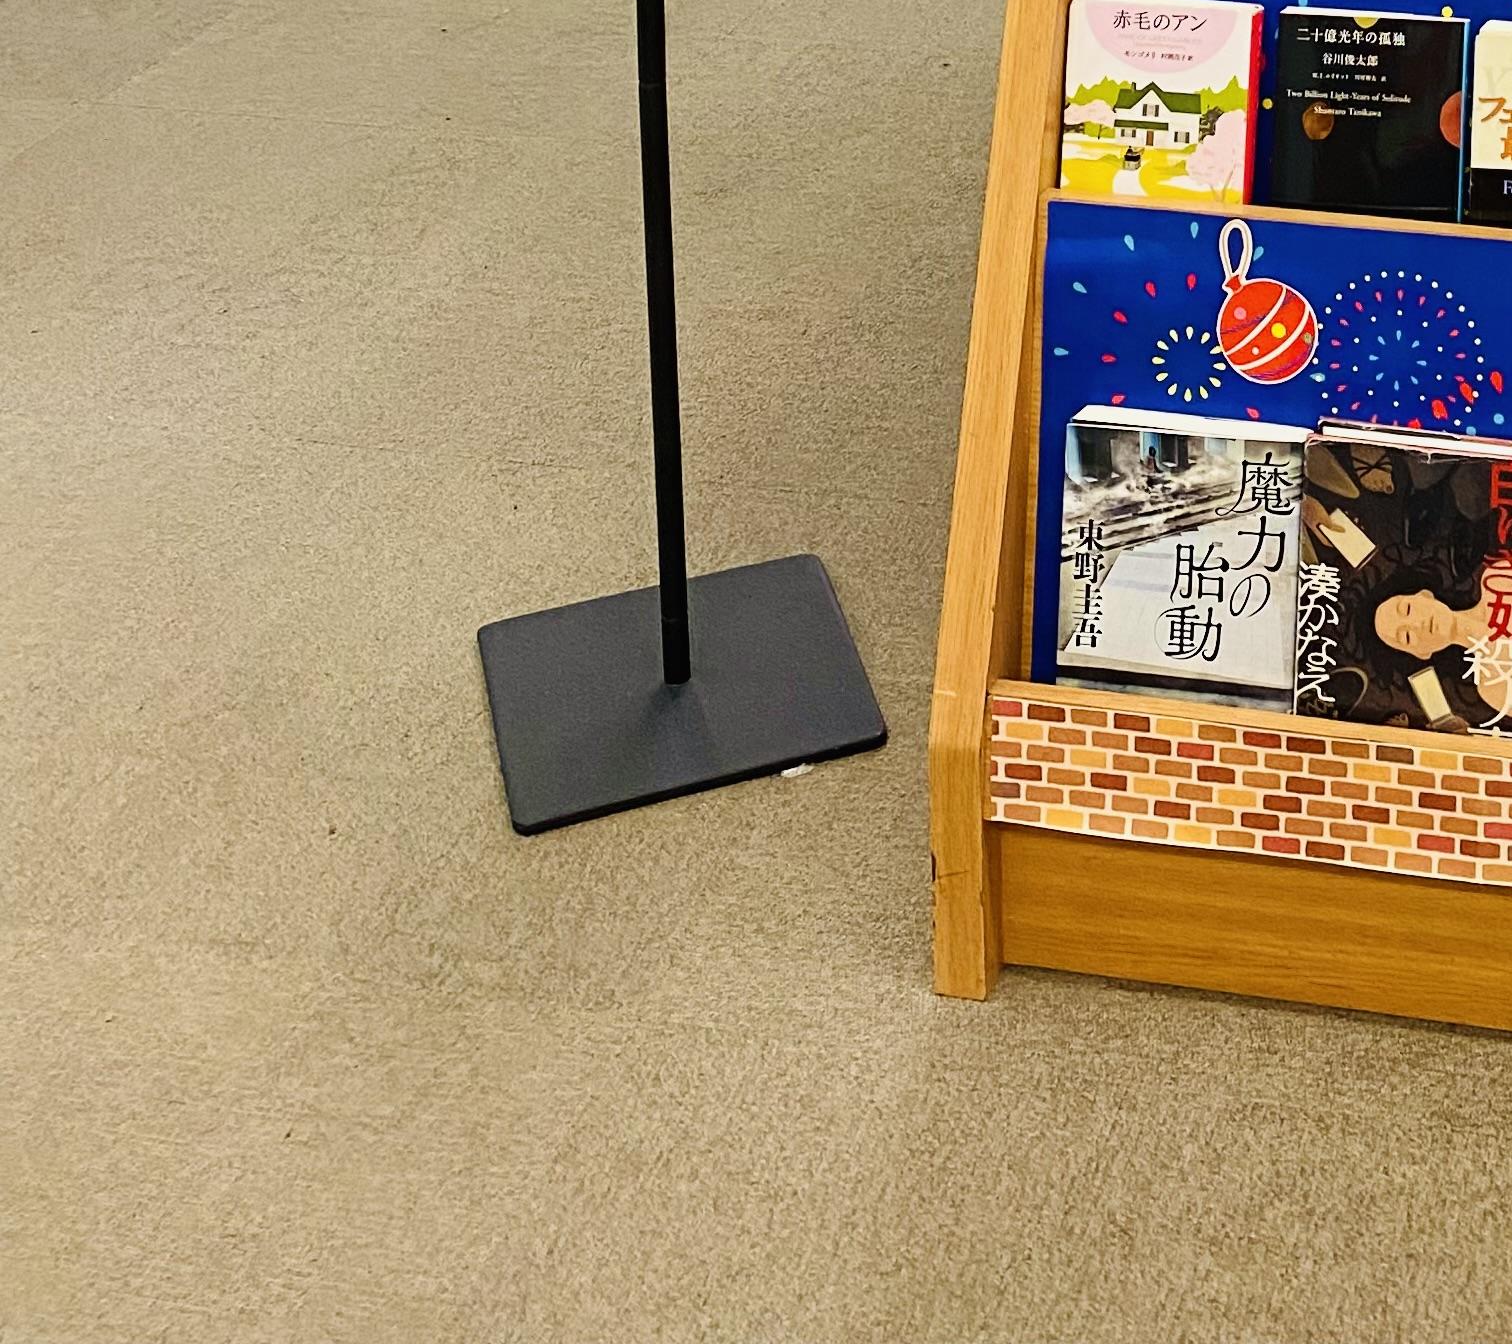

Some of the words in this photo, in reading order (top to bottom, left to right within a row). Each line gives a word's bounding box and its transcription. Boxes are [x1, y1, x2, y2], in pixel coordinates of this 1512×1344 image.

[1112, 8, 1209, 34] 赤毛のアン
[1296, 26, 1407, 49] 二十億光年の孤独
[1321, 52, 1379, 68] 谷川俊太郎
[1072, 517, 1106, 650] 東野圭吾
[1214, 451, 1298, 619] 魔力の
[1153, 542, 1230, 663] 胎動
[1295, 559, 1343, 705] 湊かなえ
